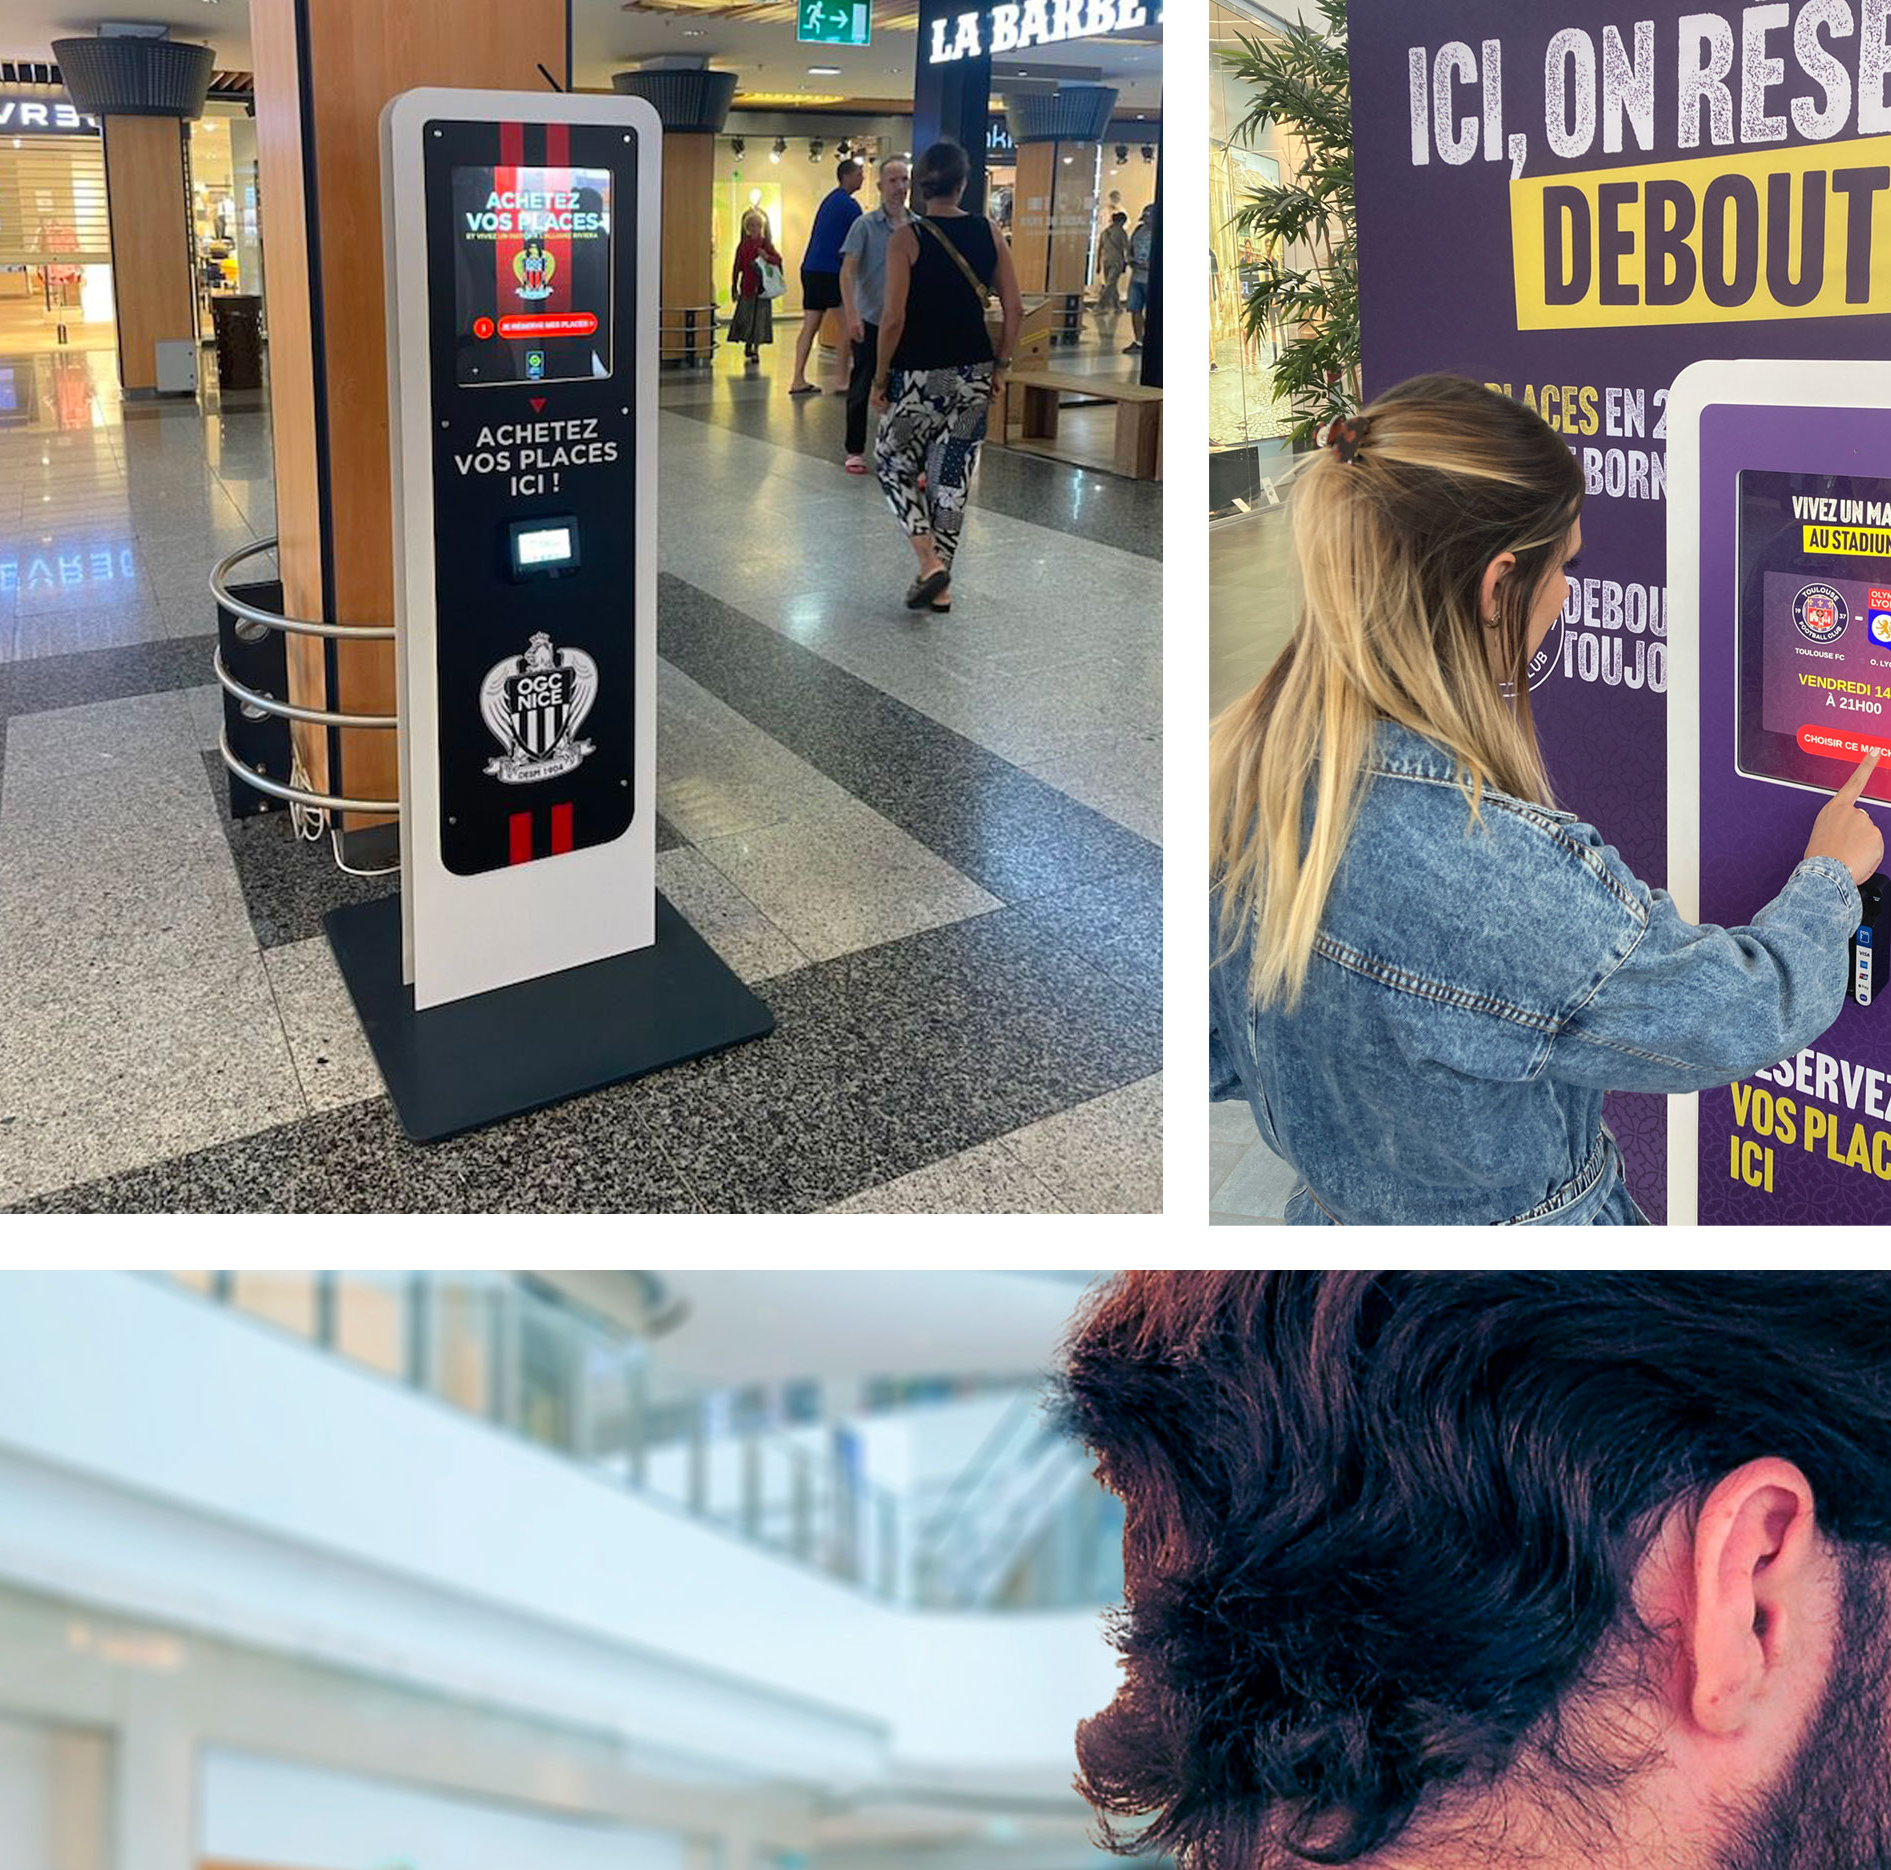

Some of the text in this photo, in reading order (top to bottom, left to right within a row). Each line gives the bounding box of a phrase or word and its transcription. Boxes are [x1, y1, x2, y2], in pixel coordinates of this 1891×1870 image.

[929, 12, 982, 64] LA
[1409, 39, 1528, 180] ICI,
[1544, 20, 1654, 158] ON
[486, 192, 580, 209] ACHETEZ
[466, 213, 599, 231] VOS PLACES
[1605, 388, 1645, 438] EN
[476, 419, 599, 448] ACHETEZ
[454, 441, 618, 476] VOS PLACES
[510, 474, 546, 497] ICI
[1792, 496, 1838, 523] VIVEZ
[1840, 500, 1864, 525] UN
[1810, 529, 1830, 549] AU
[1827, 625, 1842, 640] CLUB
[1835, 653, 1845, 661] FC
[517, 672, 563, 693] OGC
[1798, 673, 1871, 696] VENDREDI
[517, 690, 563, 710] NICE
[1839, 697, 1882, 715] 21H00
[1804, 734, 1842, 748] CHOISIR
[1845, 740, 1858, 751] CE
[1730, 1081, 1796, 1144] VOS
[1730, 1135, 1773, 1193] ICI
